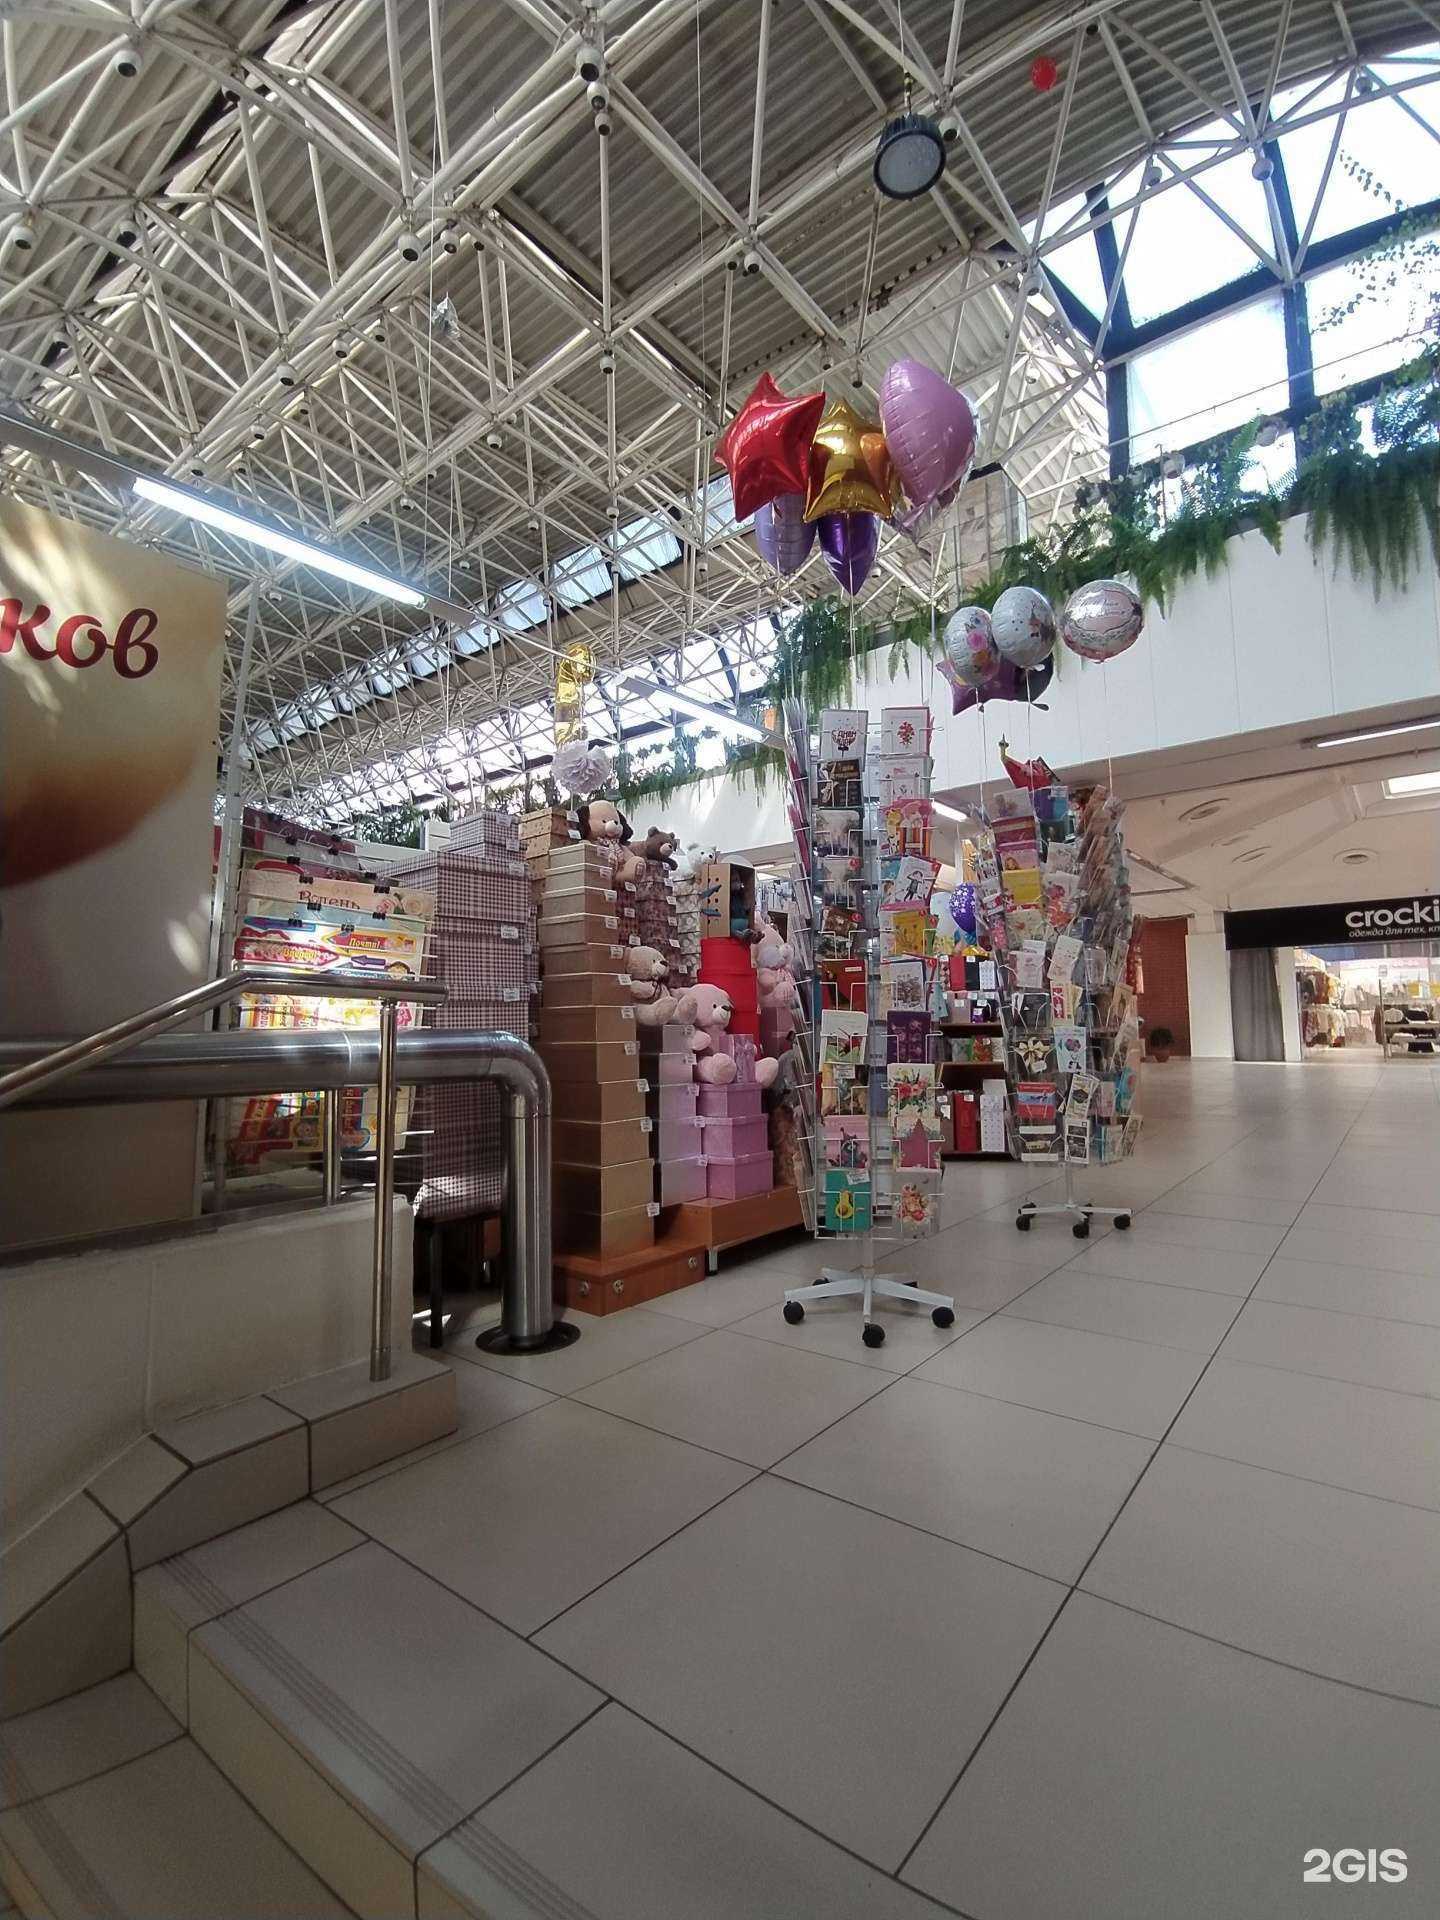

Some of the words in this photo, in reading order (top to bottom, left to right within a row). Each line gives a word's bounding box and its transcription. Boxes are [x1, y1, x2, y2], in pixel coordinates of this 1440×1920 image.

[0, 598, 159, 679] ков
[1349, 927, 1384, 938] одежда
[1385, 926, 1402, 935] для
